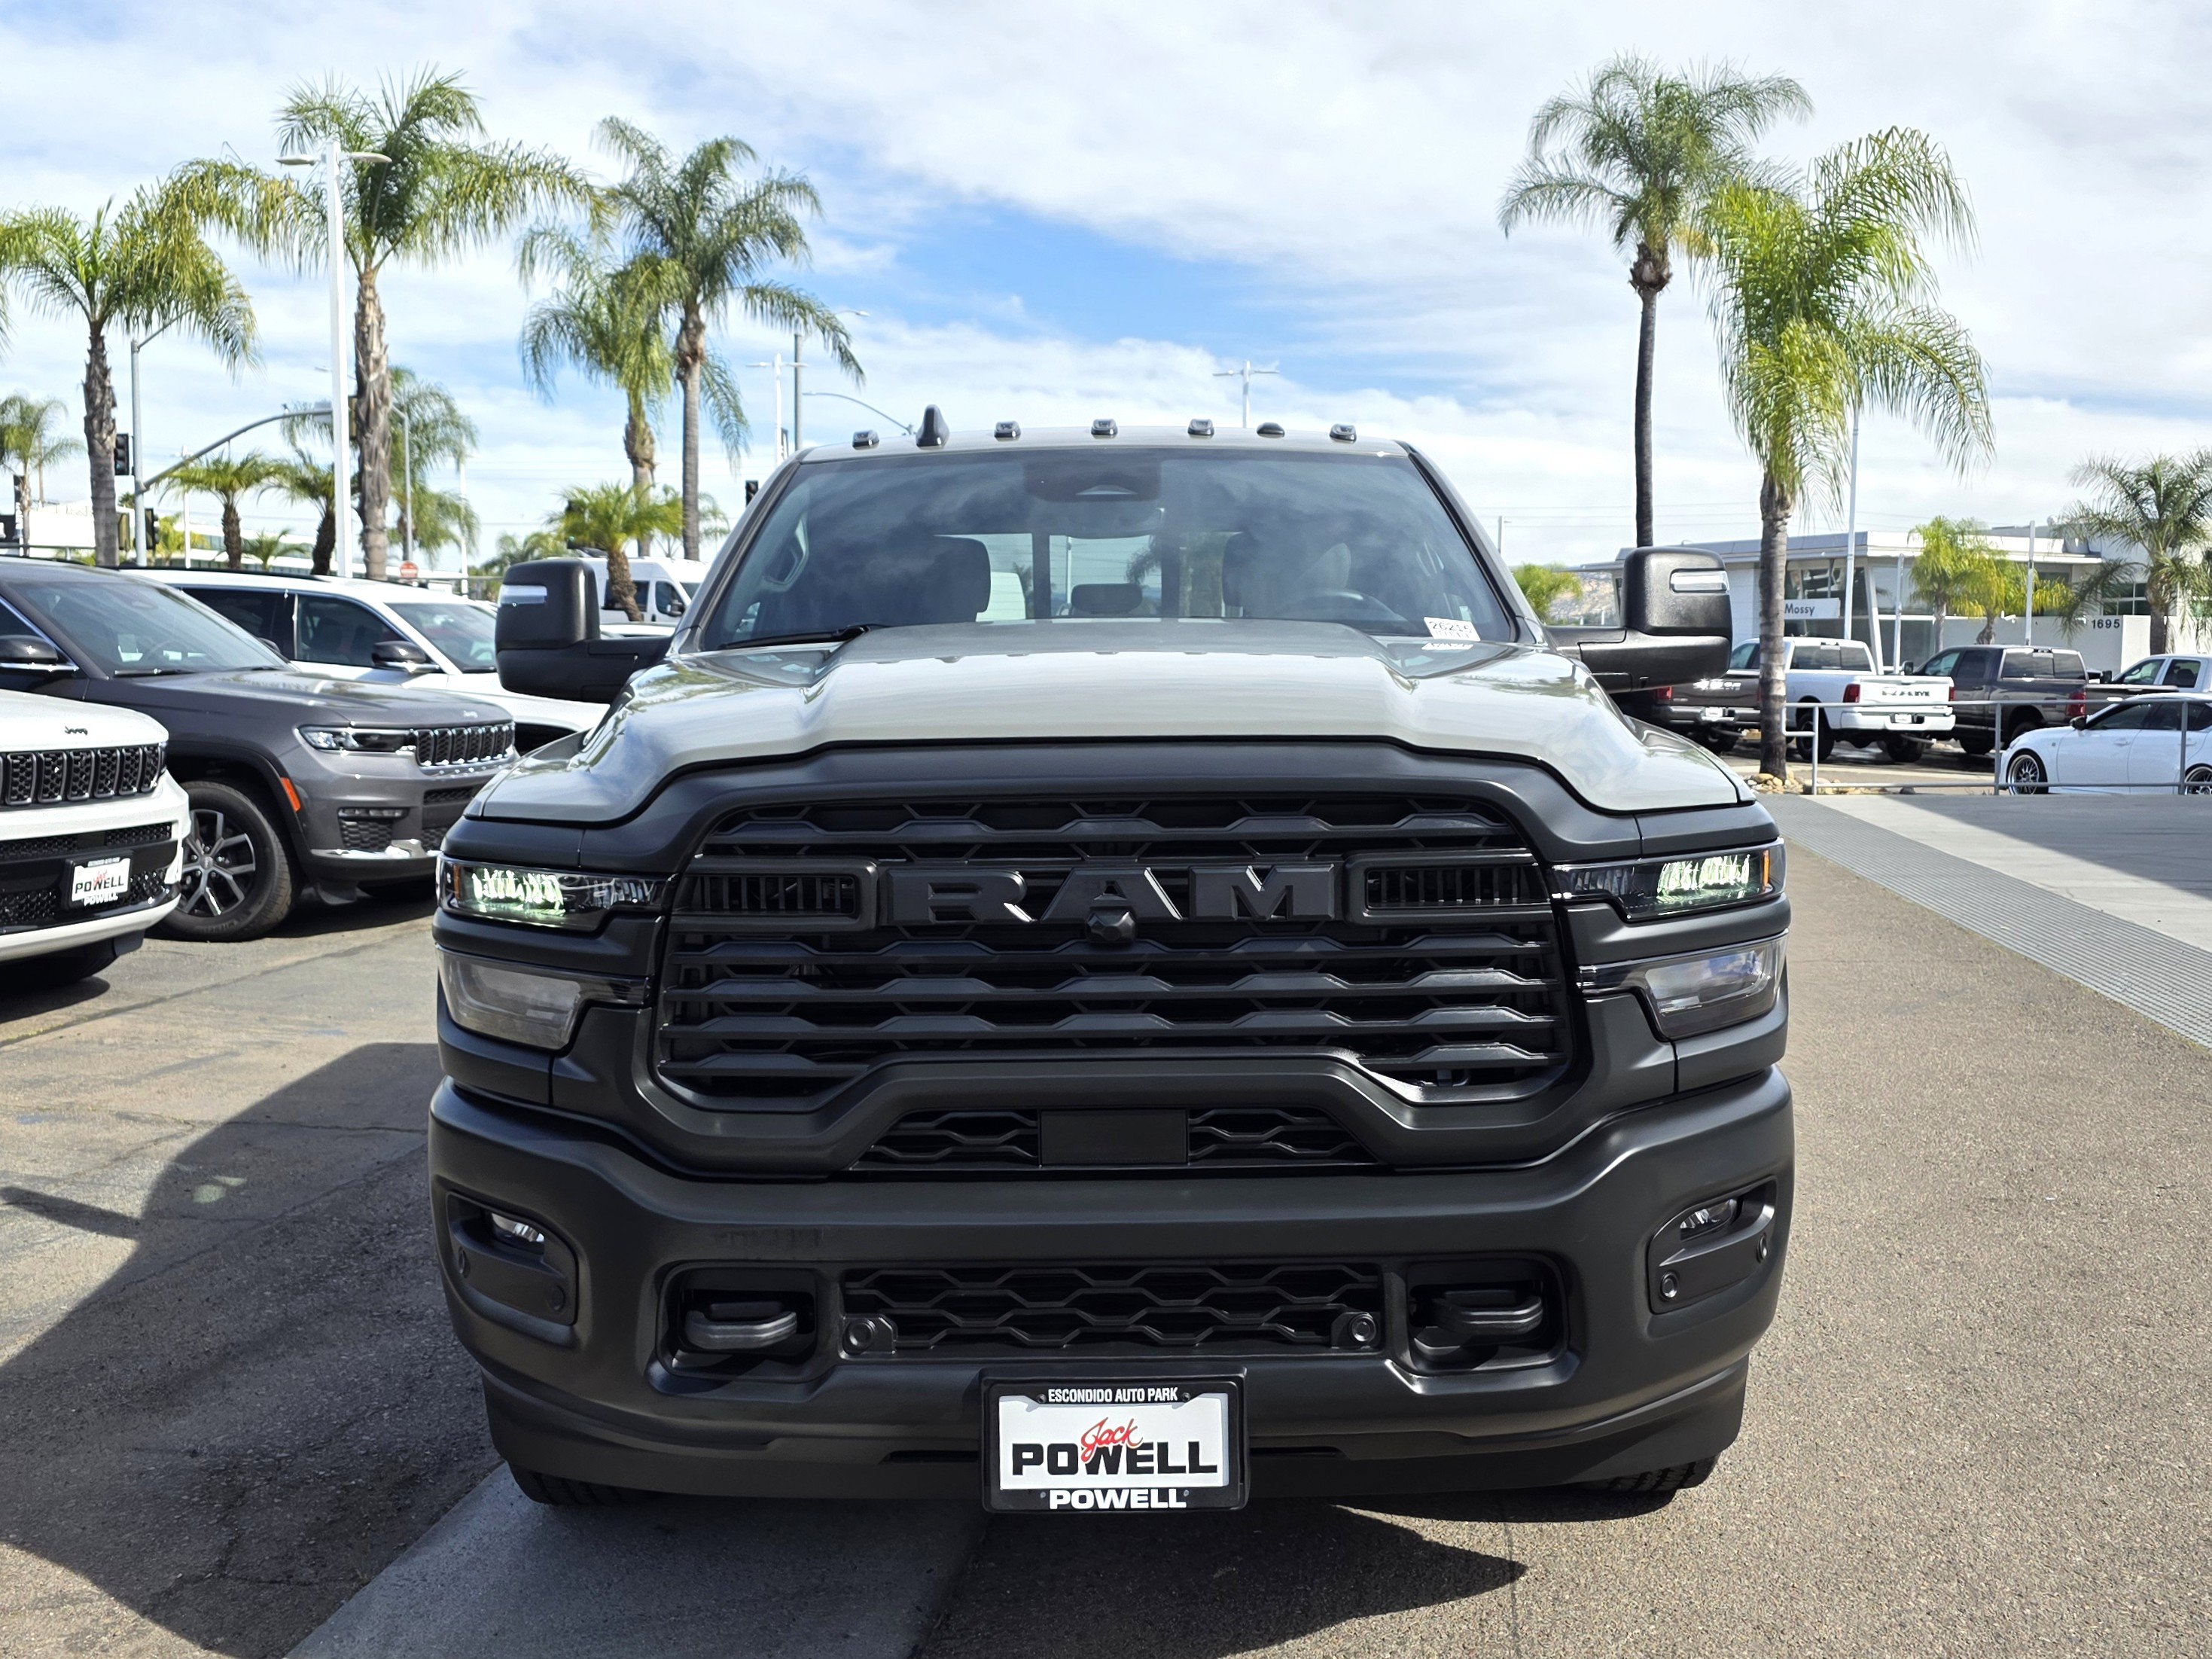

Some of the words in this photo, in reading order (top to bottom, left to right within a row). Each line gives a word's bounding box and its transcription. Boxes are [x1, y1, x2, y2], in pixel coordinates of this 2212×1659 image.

[1784, 603, 1815, 616] Mossy
[2092, 618, 2120, 630] 1695
[75, 875, 124, 894] POWELL
[887, 865, 1336, 923] RAM
[1048, 1389, 1112, 1403] ESCONDIDO
[1114, 1389, 1145, 1402] AUTO
[1147, 1387, 1178, 1401] PARK
[1080, 1417, 1144, 1462] Jack
[1012, 1441, 1217, 1475] POWELL
[1049, 1488, 1187, 1509] POWELL
